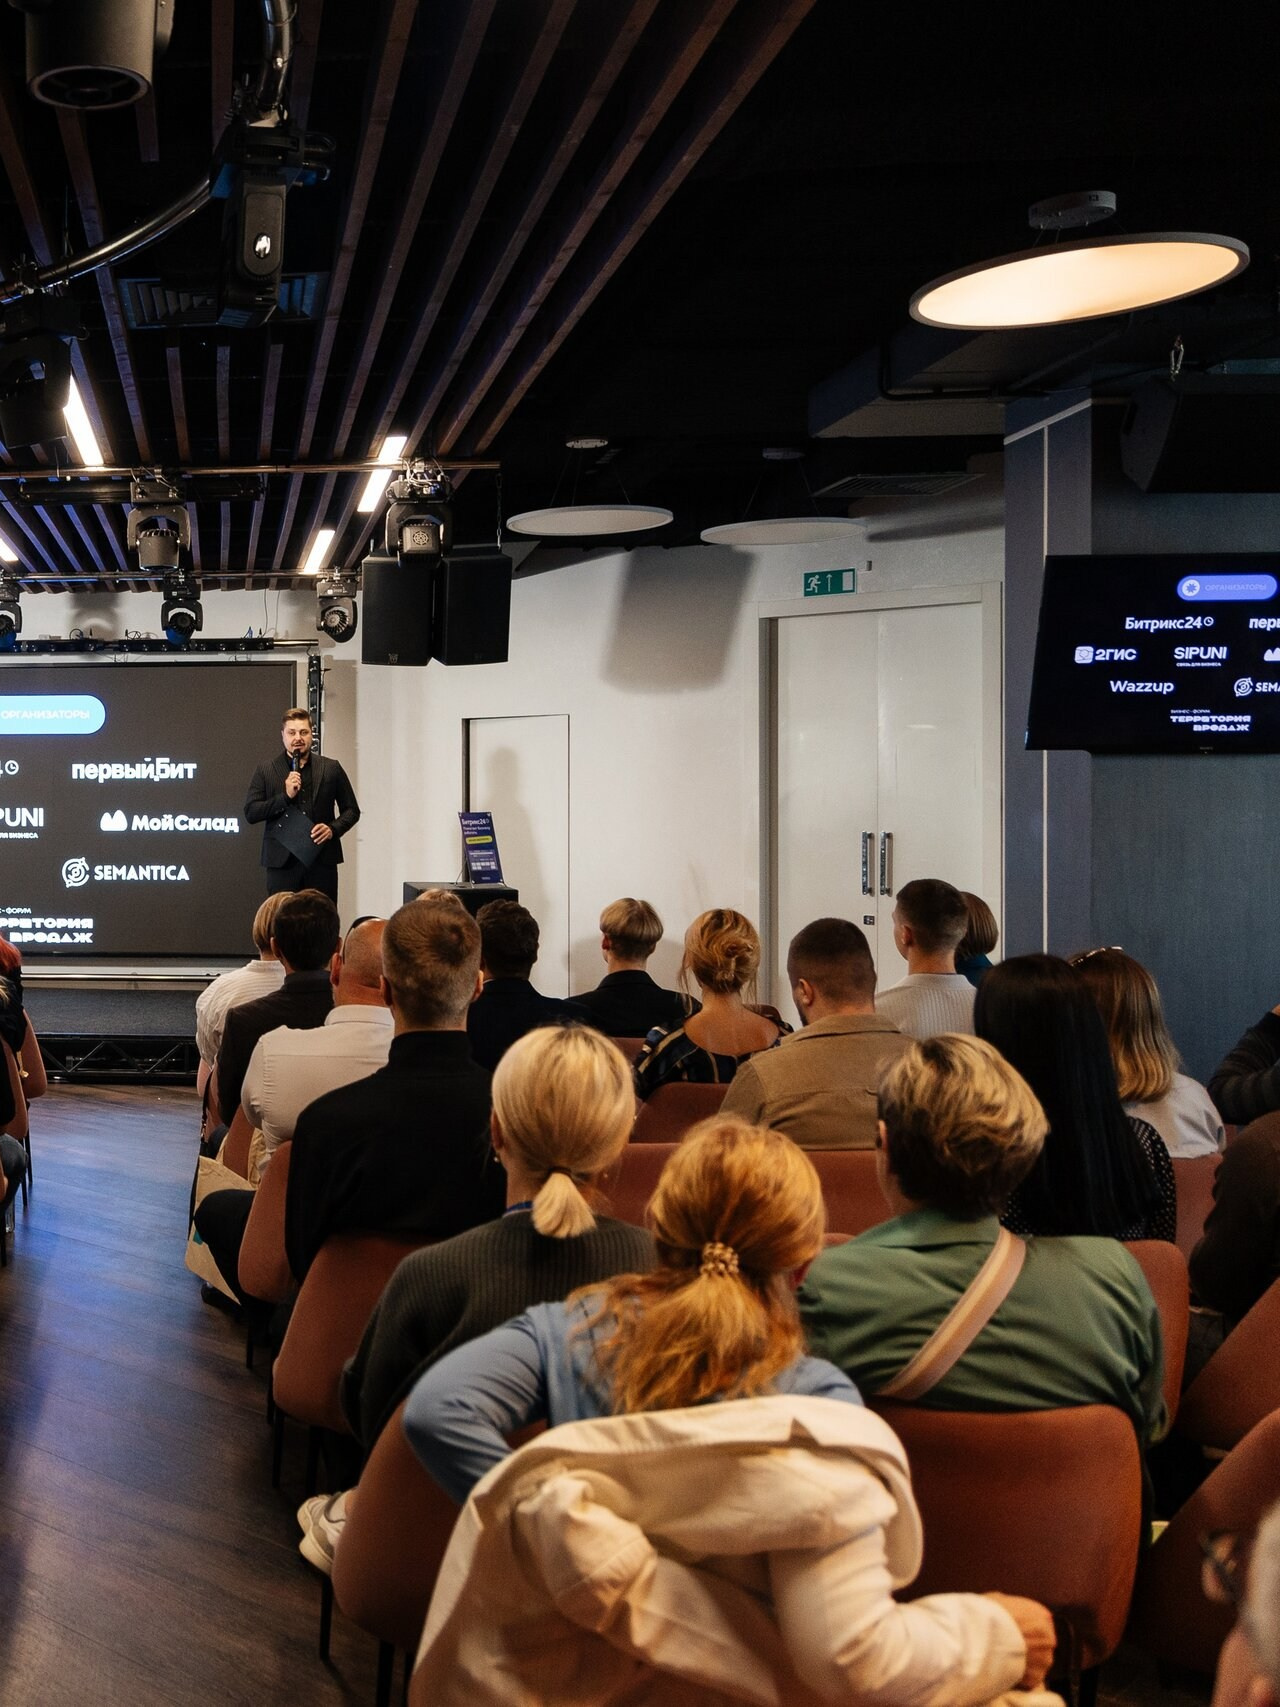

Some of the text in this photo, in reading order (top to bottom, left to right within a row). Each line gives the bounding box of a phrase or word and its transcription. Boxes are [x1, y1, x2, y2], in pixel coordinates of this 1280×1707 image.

[1124, 616, 1203, 633] Битрикс24
[1095, 648, 1138, 661] 2ГИС
[1173, 646, 1228, 660] SIPUNI
[1109, 680, 1175, 695] Wazzup
[0, 709, 91, 720] ОРГАНИЗАТОРЫ
[130, 814, 240, 833] МойСклад
[93, 864, 190, 882] SEMANTICA
